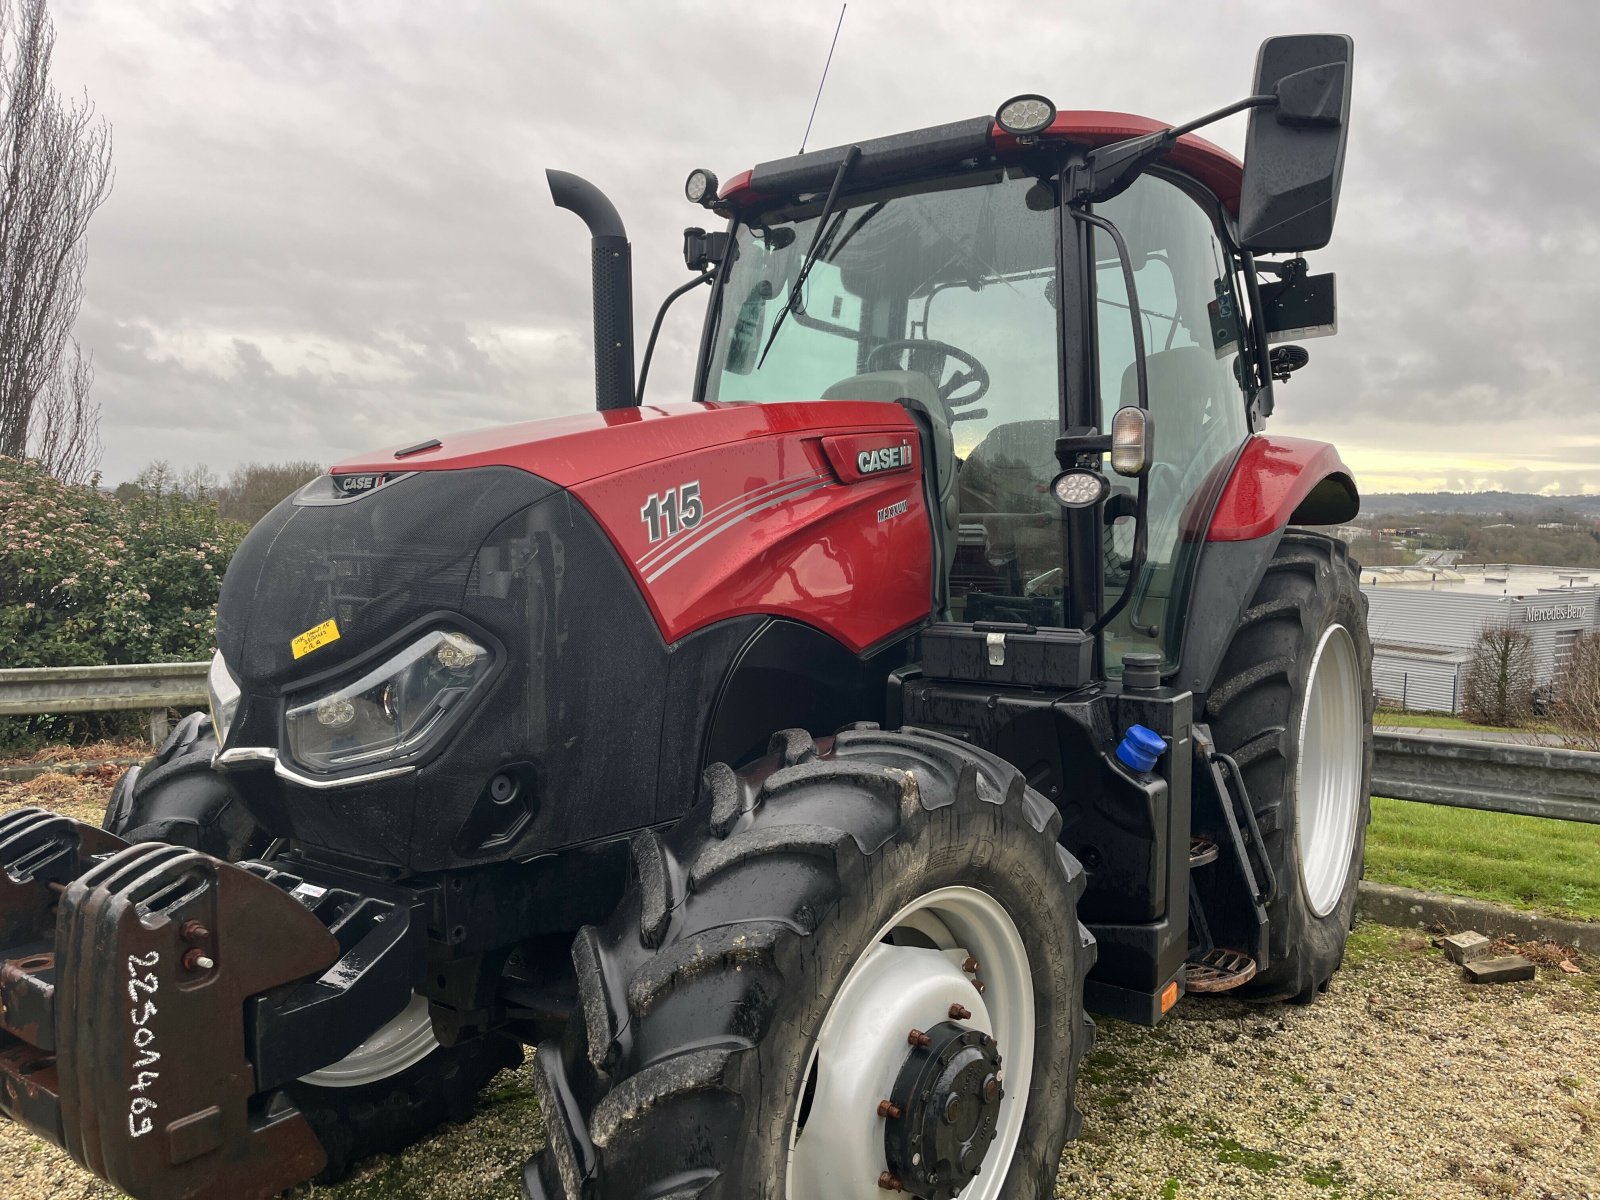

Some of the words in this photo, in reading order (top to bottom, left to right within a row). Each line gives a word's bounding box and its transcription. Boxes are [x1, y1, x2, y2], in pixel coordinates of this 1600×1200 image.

[858, 448, 899, 473] CASE
[343, 477, 373, 490] CASE
[640, 480, 704, 544] 115
[877, 500, 907, 523] MAXXUM
[1525, 604, 1586, 622] Mercedes-Benz
[128, 950, 161, 1138] 22501469
